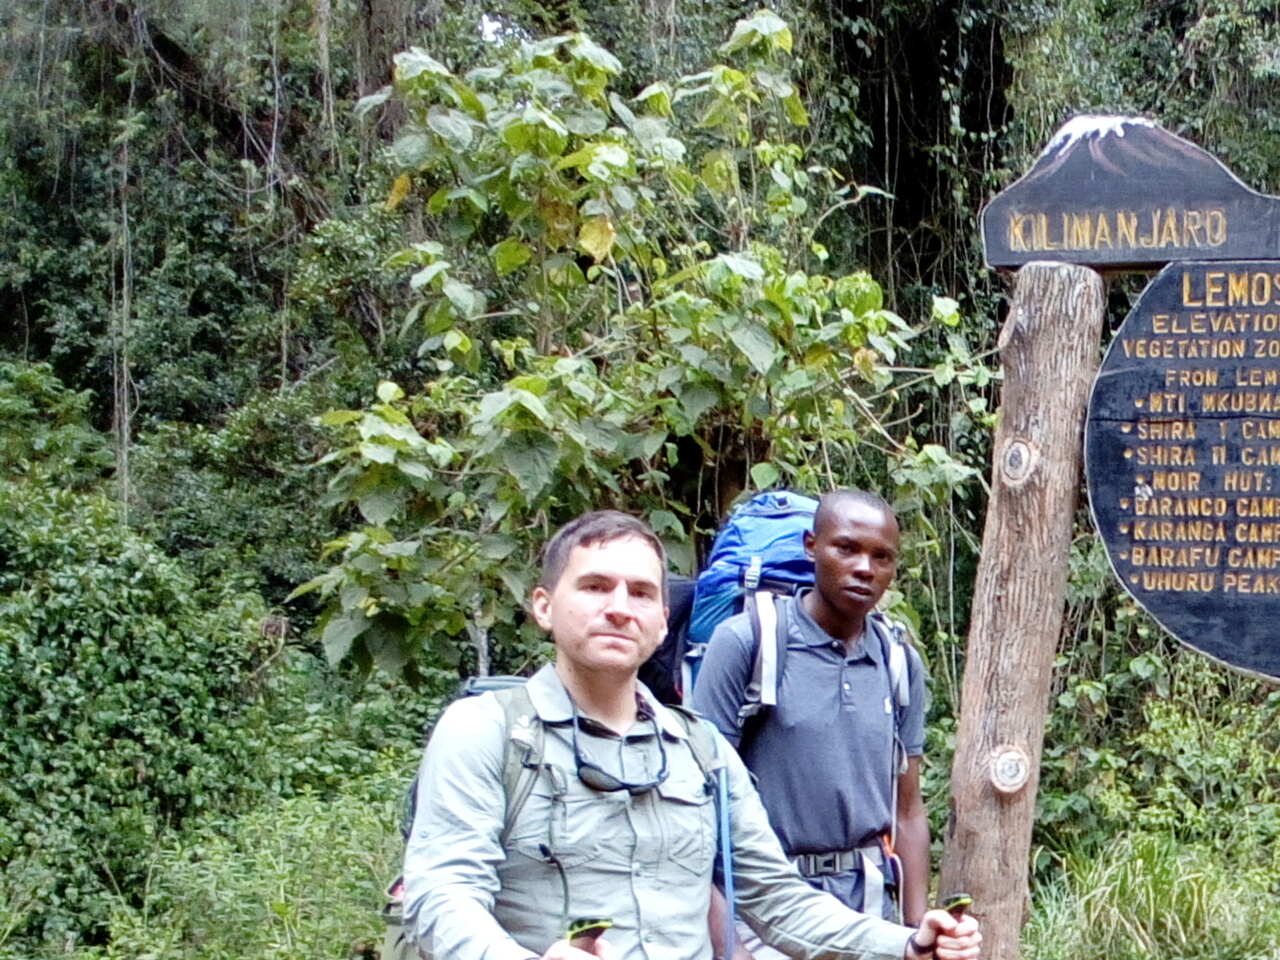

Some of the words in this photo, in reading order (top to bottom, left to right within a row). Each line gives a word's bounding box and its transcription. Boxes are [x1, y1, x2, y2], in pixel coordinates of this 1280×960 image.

[1008, 206, 1227, 251] KILIMANJARO
[1122, 339, 1245, 358] VEGETATION
[1165, 369, 1217, 386] FROM
[1150, 392, 1186, 413] MTI
[1137, 419, 1196, 440] SHIRA
[1137, 446, 1196, 466] SHIRA
[1224, 471, 1273, 492] HUT:
[1134, 497, 1227, 517] BARANCO
[1134, 521, 1226, 542] KARANGA
[1131, 547, 1220, 568] BARAFU
[1142, 572, 1215, 592] UHURU
